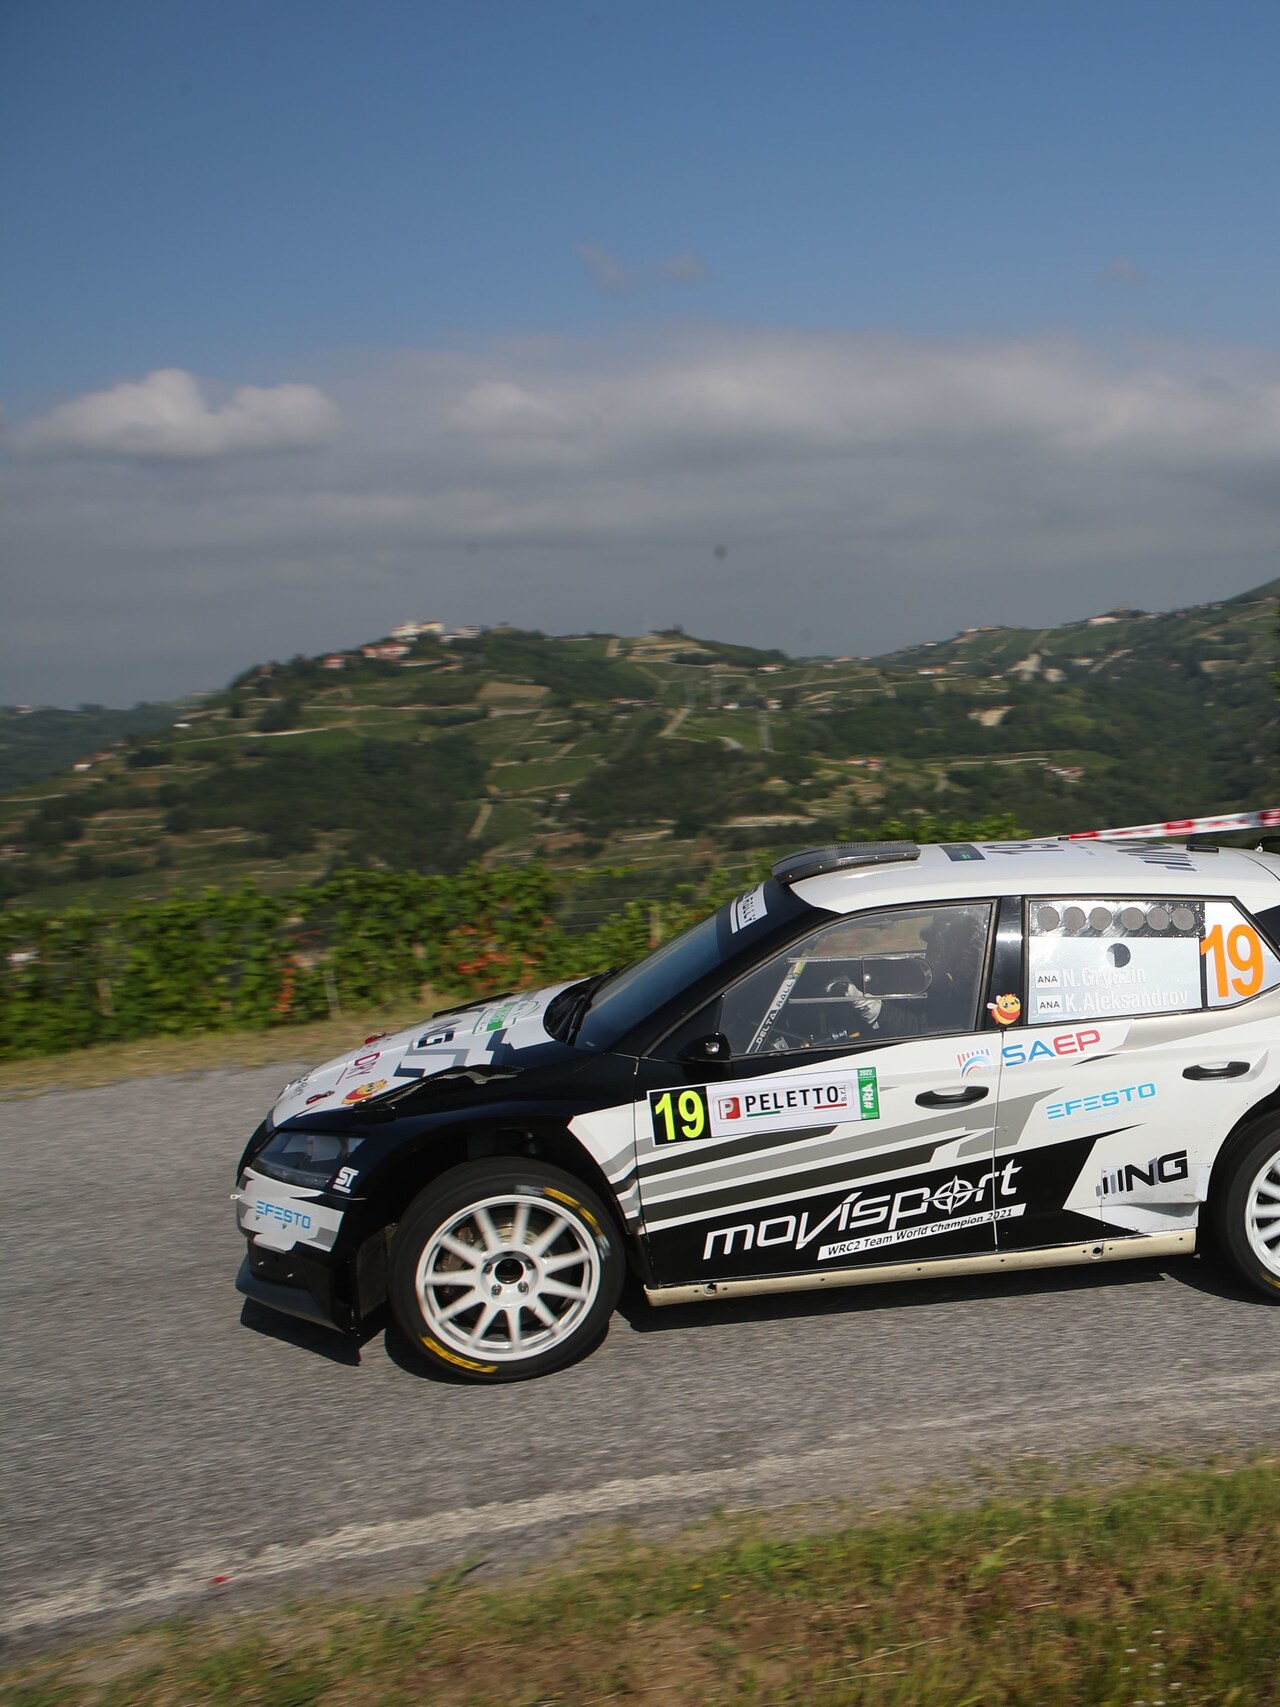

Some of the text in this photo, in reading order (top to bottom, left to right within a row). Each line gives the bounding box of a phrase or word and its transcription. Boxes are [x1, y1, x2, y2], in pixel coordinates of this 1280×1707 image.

[1200, 924, 1264, 998] 19
[1037, 974, 1058, 984] ANA
[755, 979, 796, 1045] DELTA RALL
[1039, 989, 1188, 1013] ANA K.Aleksandrov
[1002, 1029, 1101, 1067] SAEP
[859, 1069, 873, 1077] 2022
[862, 1083, 875, 1109] #RA
[1046, 1082, 1156, 1120] EFESTO
[655, 1090, 705, 1141] 19
[745, 1086, 839, 1113] PELETTO
[335, 1166, 359, 1188] ST
[255, 1200, 312, 1230] EFESTO
[828, 1208, 1013, 1256] WRC2 Team World Champion 2021
